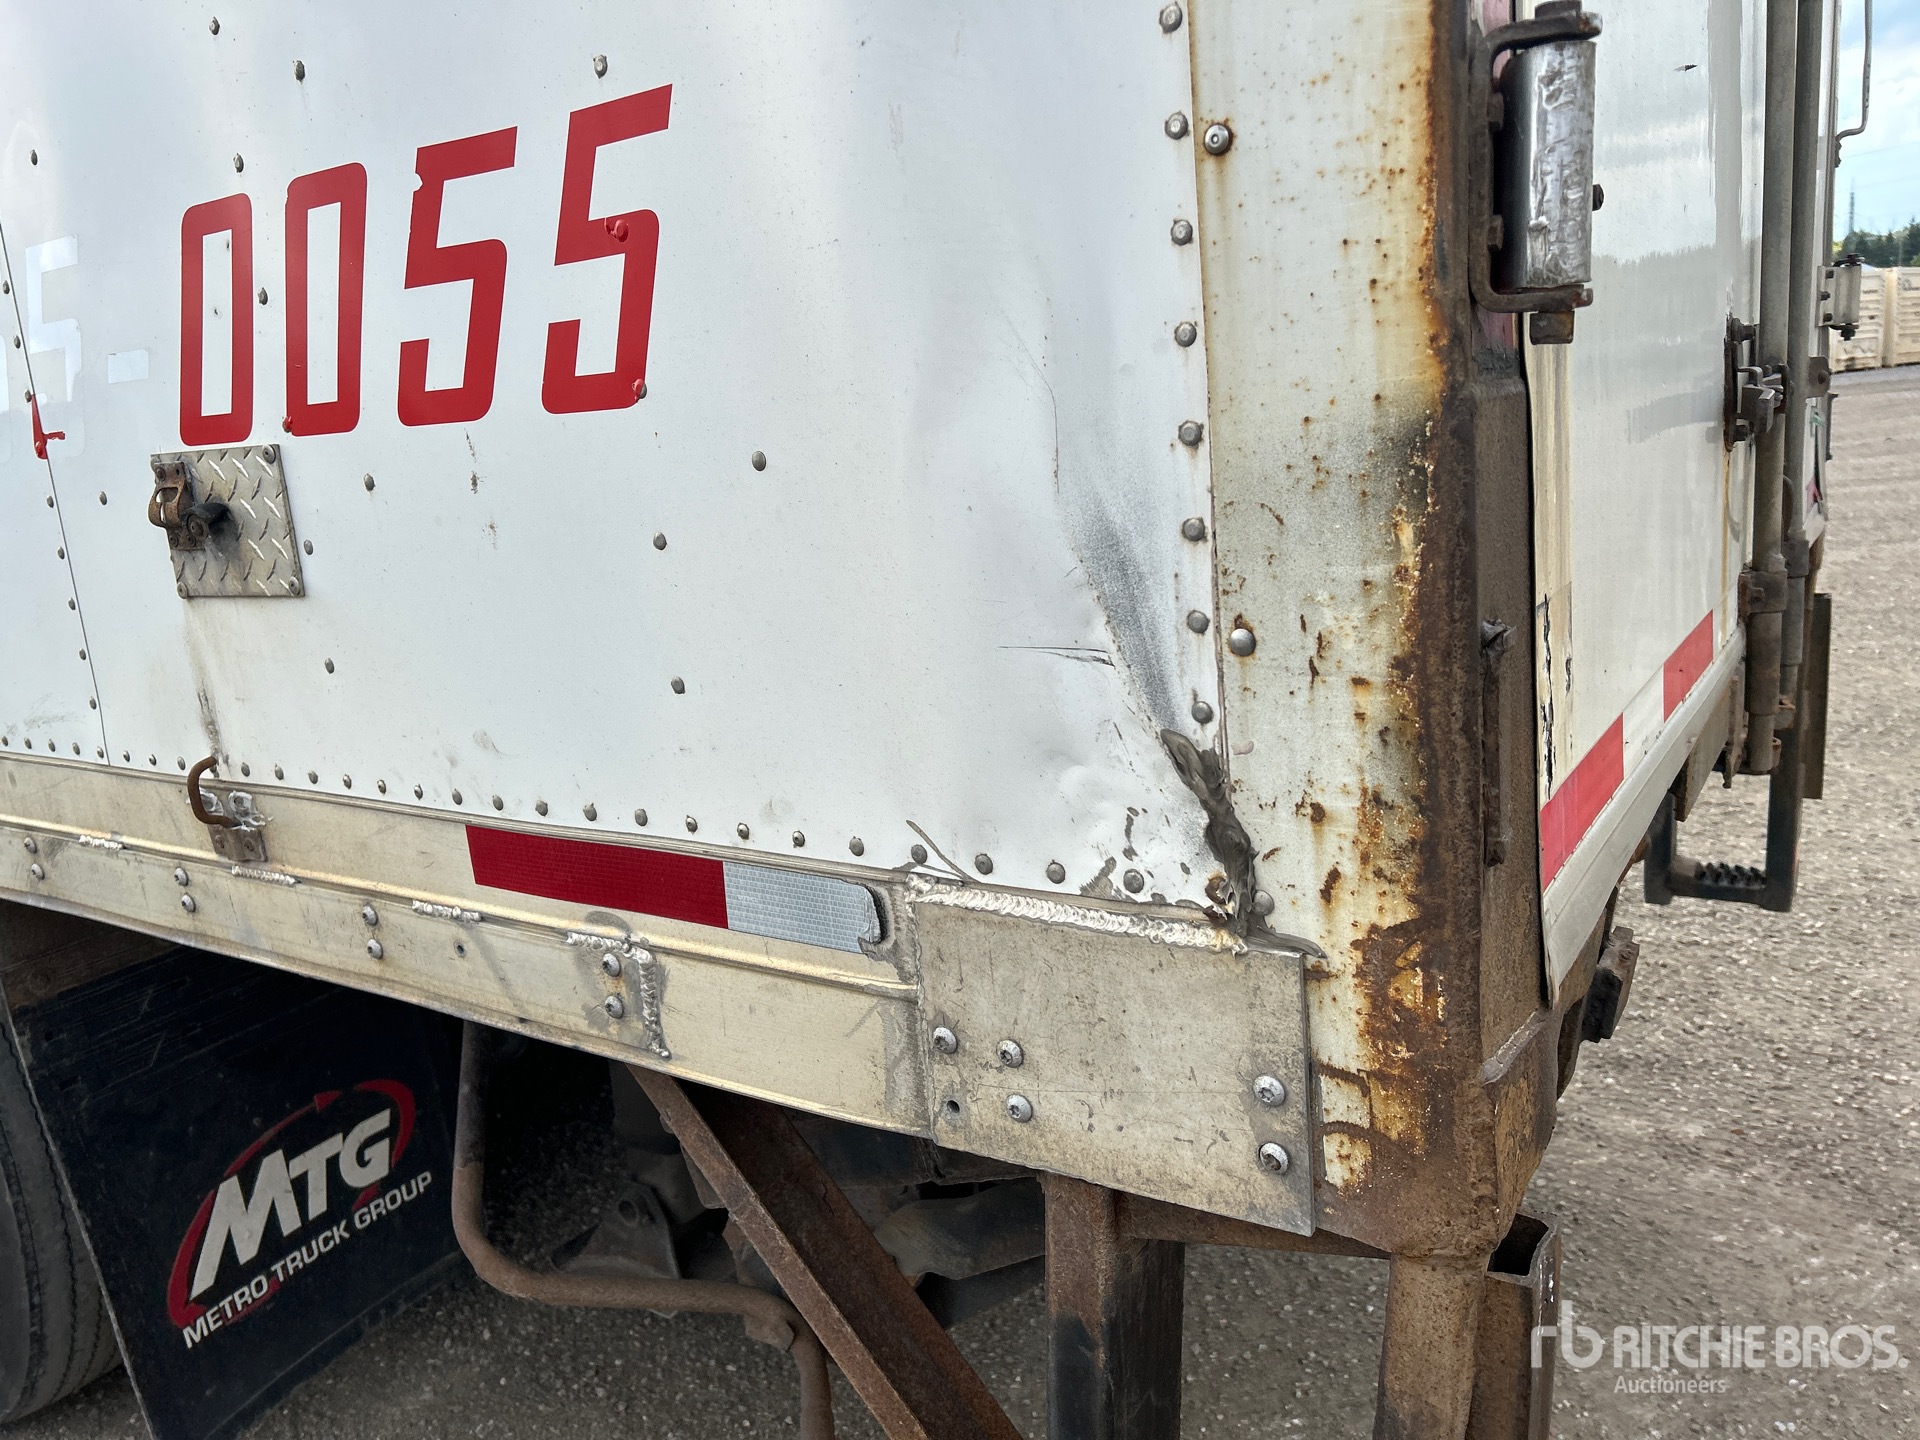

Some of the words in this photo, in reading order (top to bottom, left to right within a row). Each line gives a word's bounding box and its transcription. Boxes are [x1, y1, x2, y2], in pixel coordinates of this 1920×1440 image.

[180, 83, 673, 446] 0055
[182, 1273, 270, 1349] METRO
[271, 1218, 350, 1284] TRUCK
[353, 1171, 432, 1231] GROUP
[190, 1107, 392, 1300] MTG
